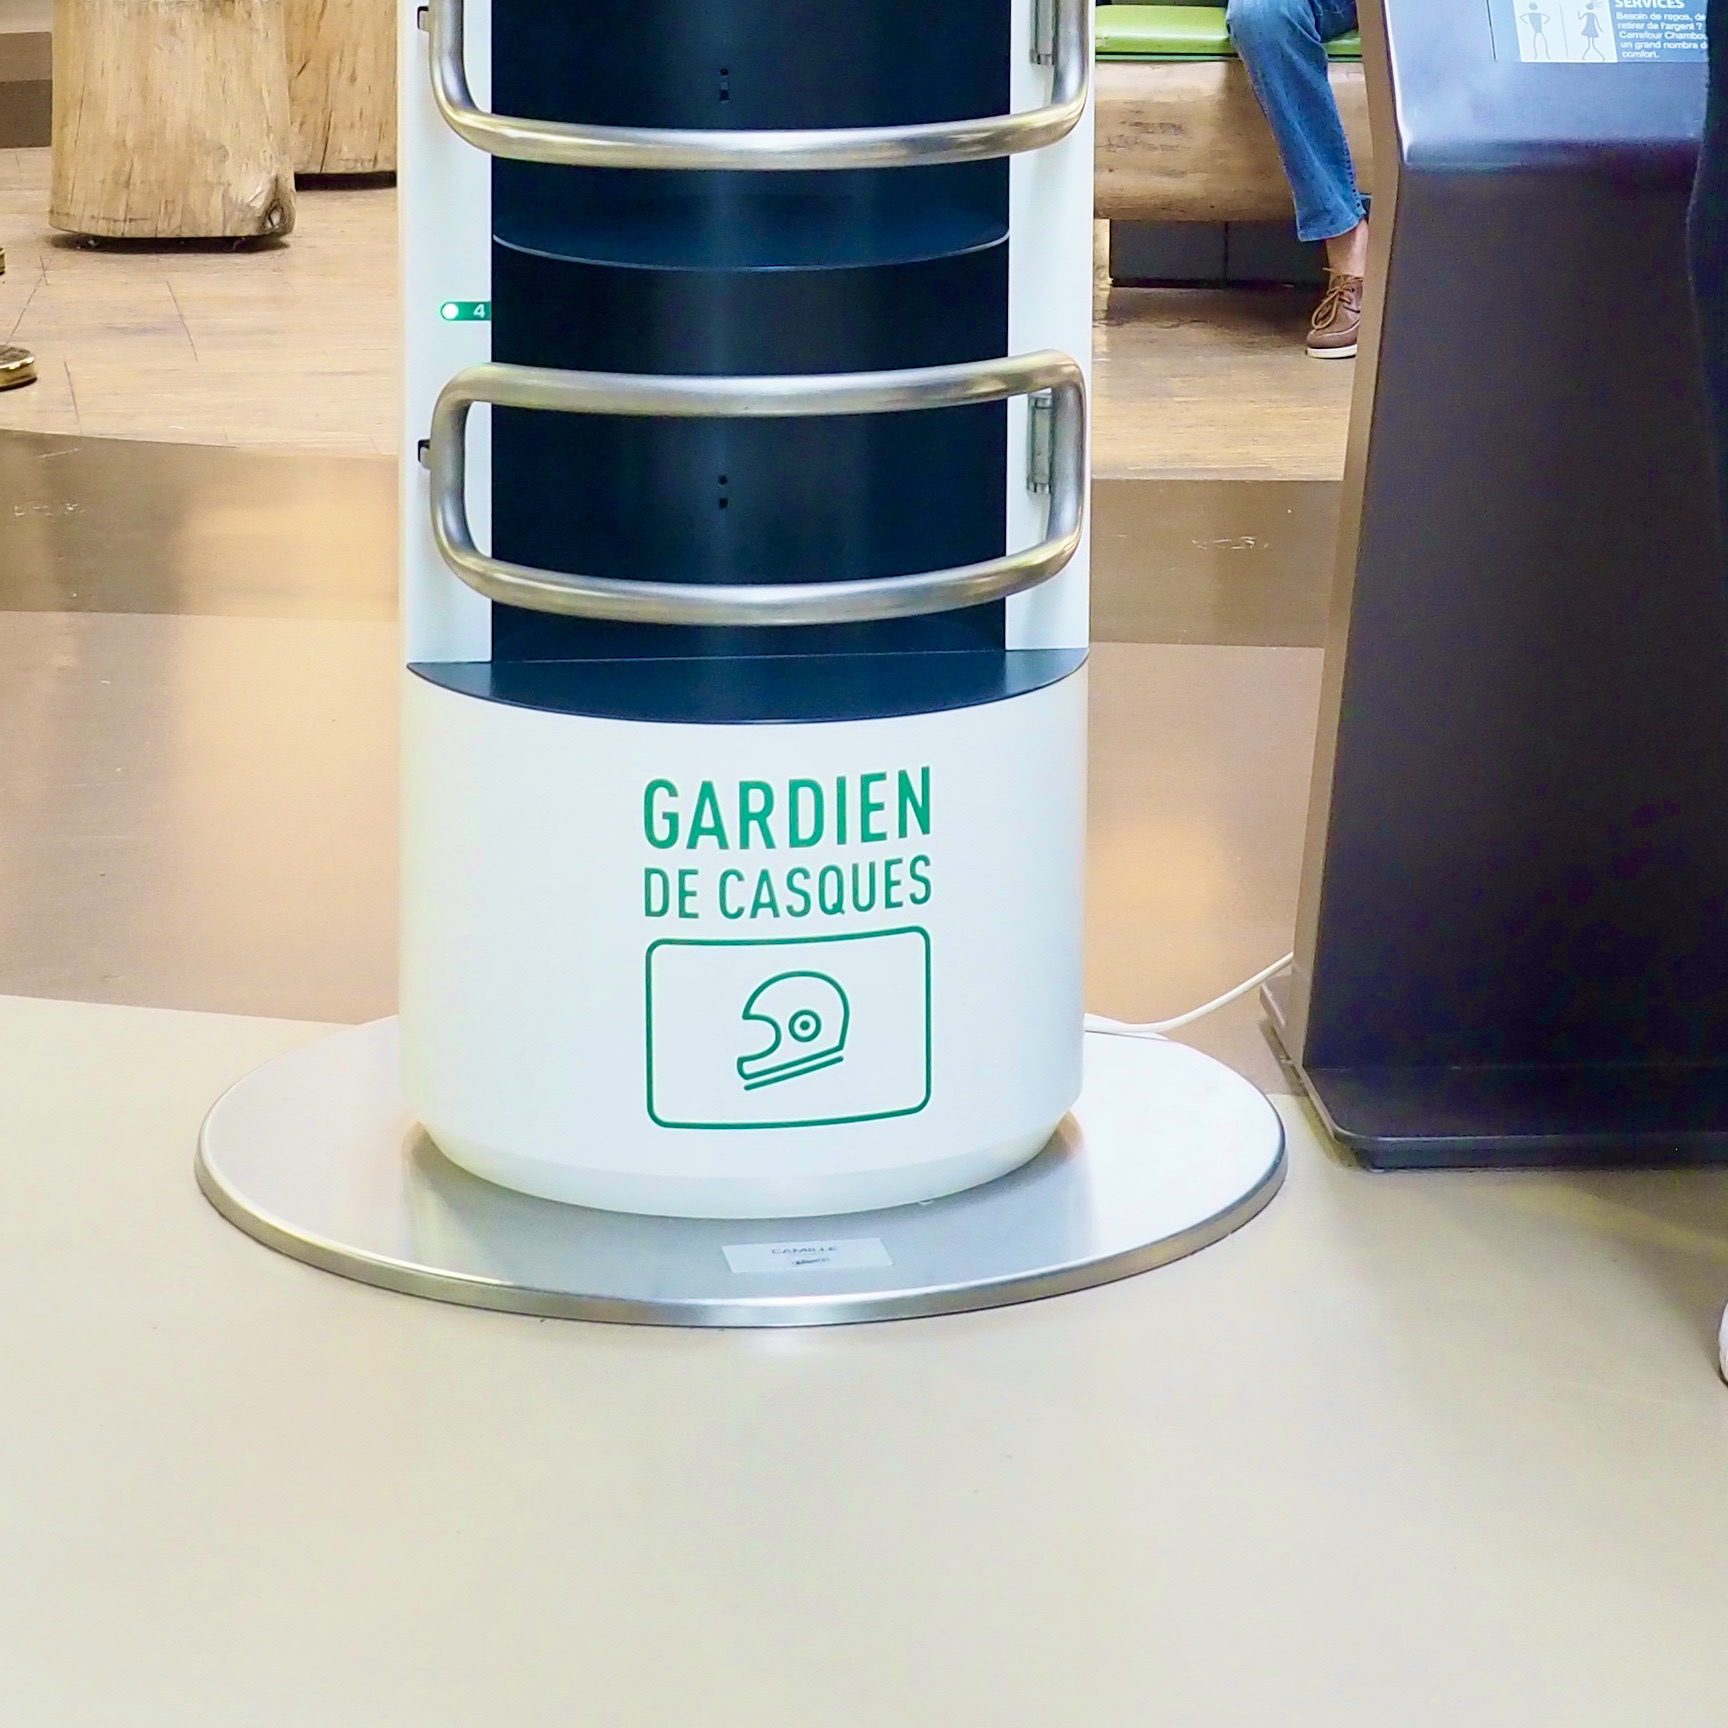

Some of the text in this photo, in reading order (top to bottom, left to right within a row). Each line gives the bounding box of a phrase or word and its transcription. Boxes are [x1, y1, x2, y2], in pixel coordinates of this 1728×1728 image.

[1616, 12, 1648, 20] Besoin
[1649, 12, 1662, 20] de
[1619, 30, 1663, 40] Carrefour
[1634, 40, 1662, 50] grand
[1663, 41, 1699, 49] nombre
[472, 303, 486, 319] 4
[643, 766, 932, 851] GARDIEN
[644, 854, 932, 920] DE CASQUES
